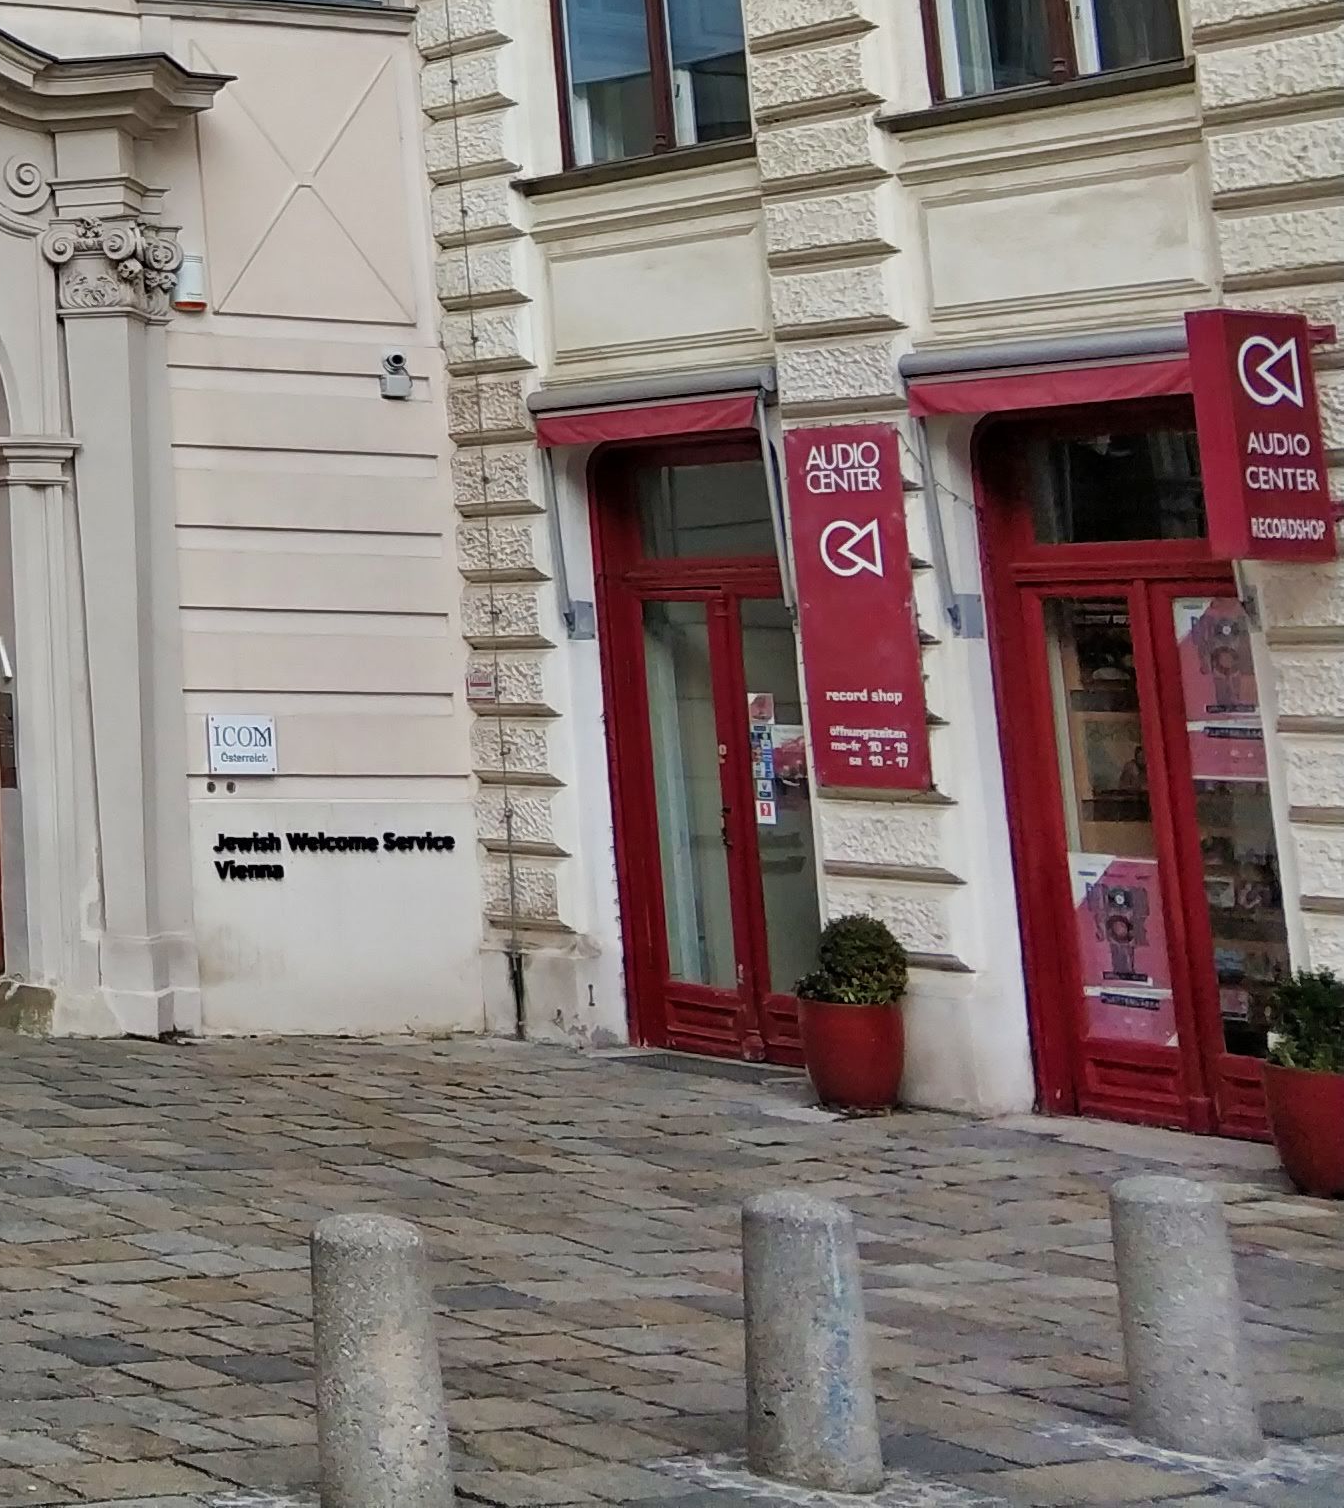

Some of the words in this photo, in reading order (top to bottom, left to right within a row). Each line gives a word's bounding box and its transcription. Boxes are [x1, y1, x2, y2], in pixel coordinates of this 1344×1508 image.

[1247, 431, 1311, 456] AUDIO
[805, 441, 880, 471] AUDIO
[806, 467, 882, 494] CENTER
[1245, 466, 1320, 491] CENTER
[1250, 517, 1326, 541] RECORDSHOP
[825, 688, 868, 702] record
[871, 688, 903, 706] shop
[213, 725, 273, 748] ICOM
[867, 740, 882, 752] 10
[868, 755, 883, 767] 10
[895, 756, 909, 768] 17
[213, 831, 282, 853] Jewish
[285, 831, 380, 853] Welcome
[382, 830, 456, 853] Service
[214, 859, 285, 881] Vienna
